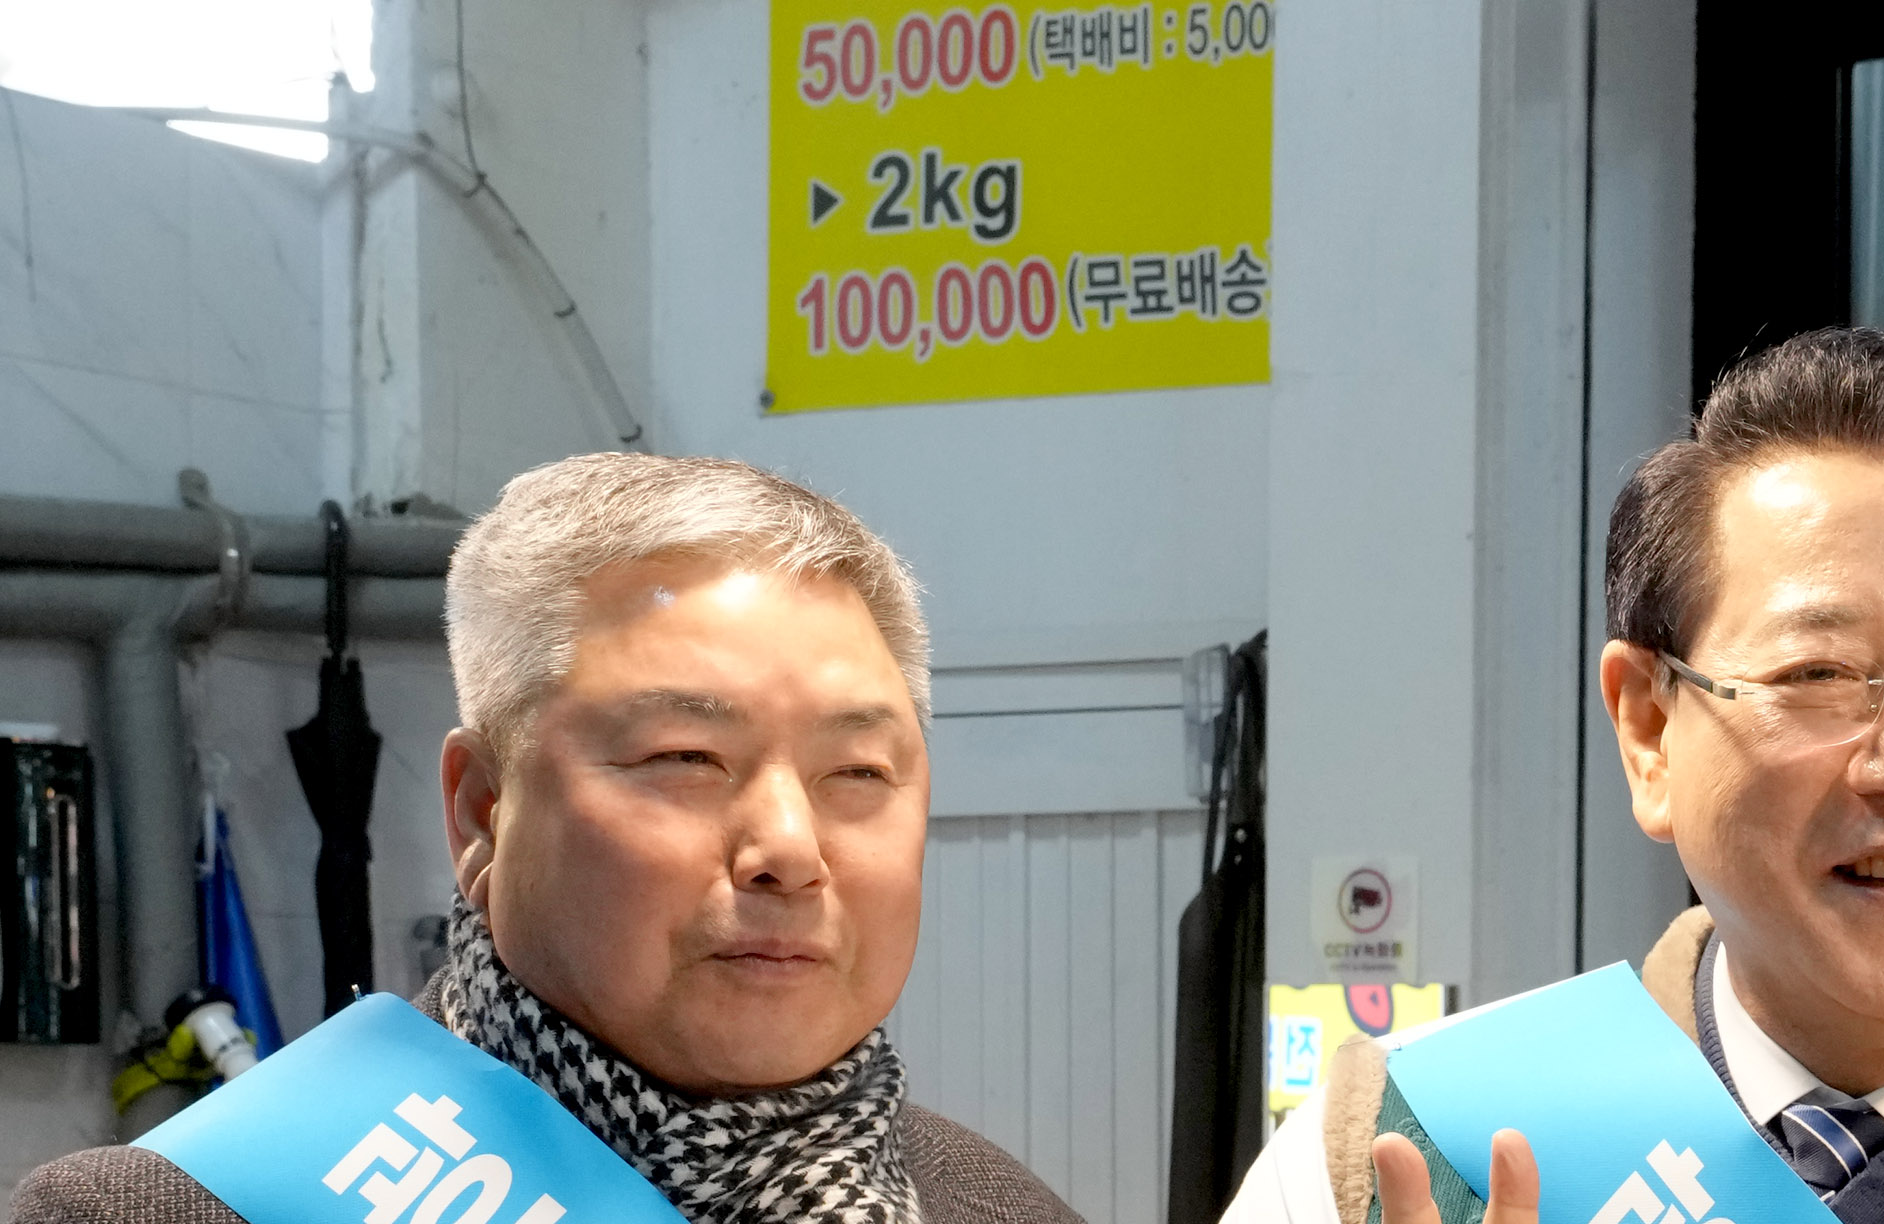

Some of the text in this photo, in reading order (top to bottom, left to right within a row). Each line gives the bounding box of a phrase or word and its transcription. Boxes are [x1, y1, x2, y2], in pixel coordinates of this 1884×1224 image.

[803, 10, 1015, 108] 50,000
[1029, 5, 1150, 75] (택배비
[1188, 2, 1276, 62] 5,00
[870, 154, 1019, 239] 2kg
[800, 249, 1267, 357] 100,000 (무료배송
